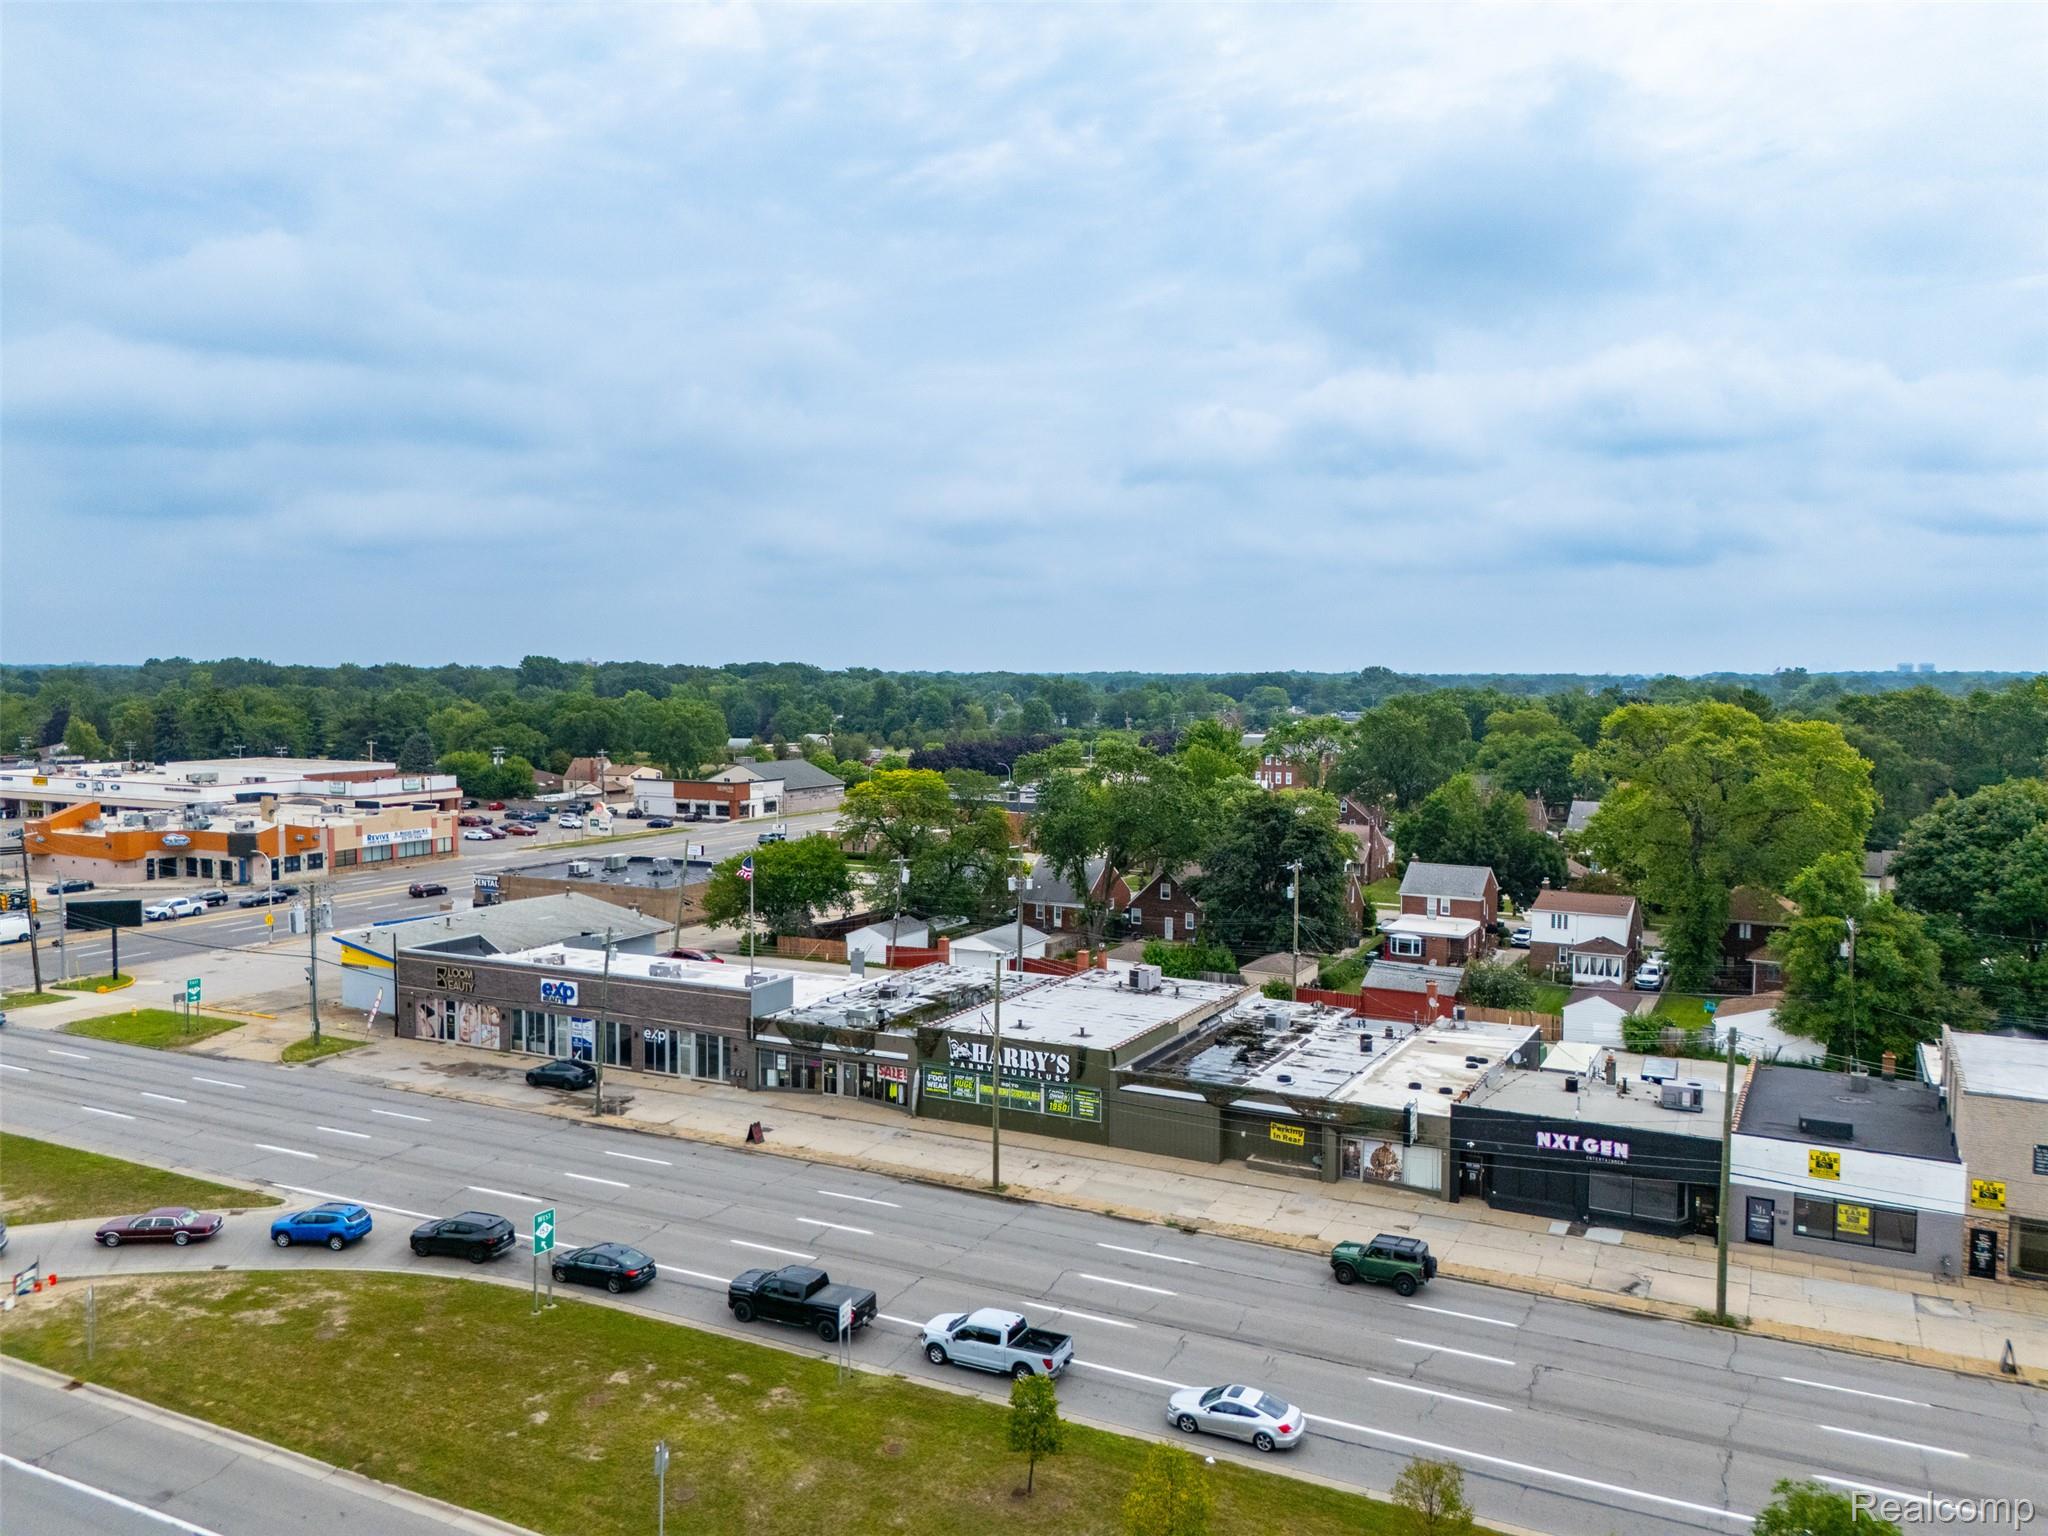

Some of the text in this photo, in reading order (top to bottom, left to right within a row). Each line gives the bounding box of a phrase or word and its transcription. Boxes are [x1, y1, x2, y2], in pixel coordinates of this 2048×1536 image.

[472, 878, 499, 888] DENTAL
[644, 1029, 666, 1044] exp
[971, 1043, 1070, 1075] HARRY'S
[879, 1065, 907, 1080] SALE!
[960, 1062, 1060, 1082] ARMY SURPLUS
[928, 1074, 947, 1082] FOOT
[926, 1081, 948, 1090] WEAR
[953, 1079, 974, 1089] HUGE
[1271, 1123, 1303, 1137] Parking
[1283, 1134, 1302, 1142] Rear
[1537, 1132, 1628, 1158] NXT GEN
[1810, 1155, 1839, 1163] LEASE
[1973, 1184, 2003, 1193] LEASE
[1839, 1209, 1868, 1217] LEASE
